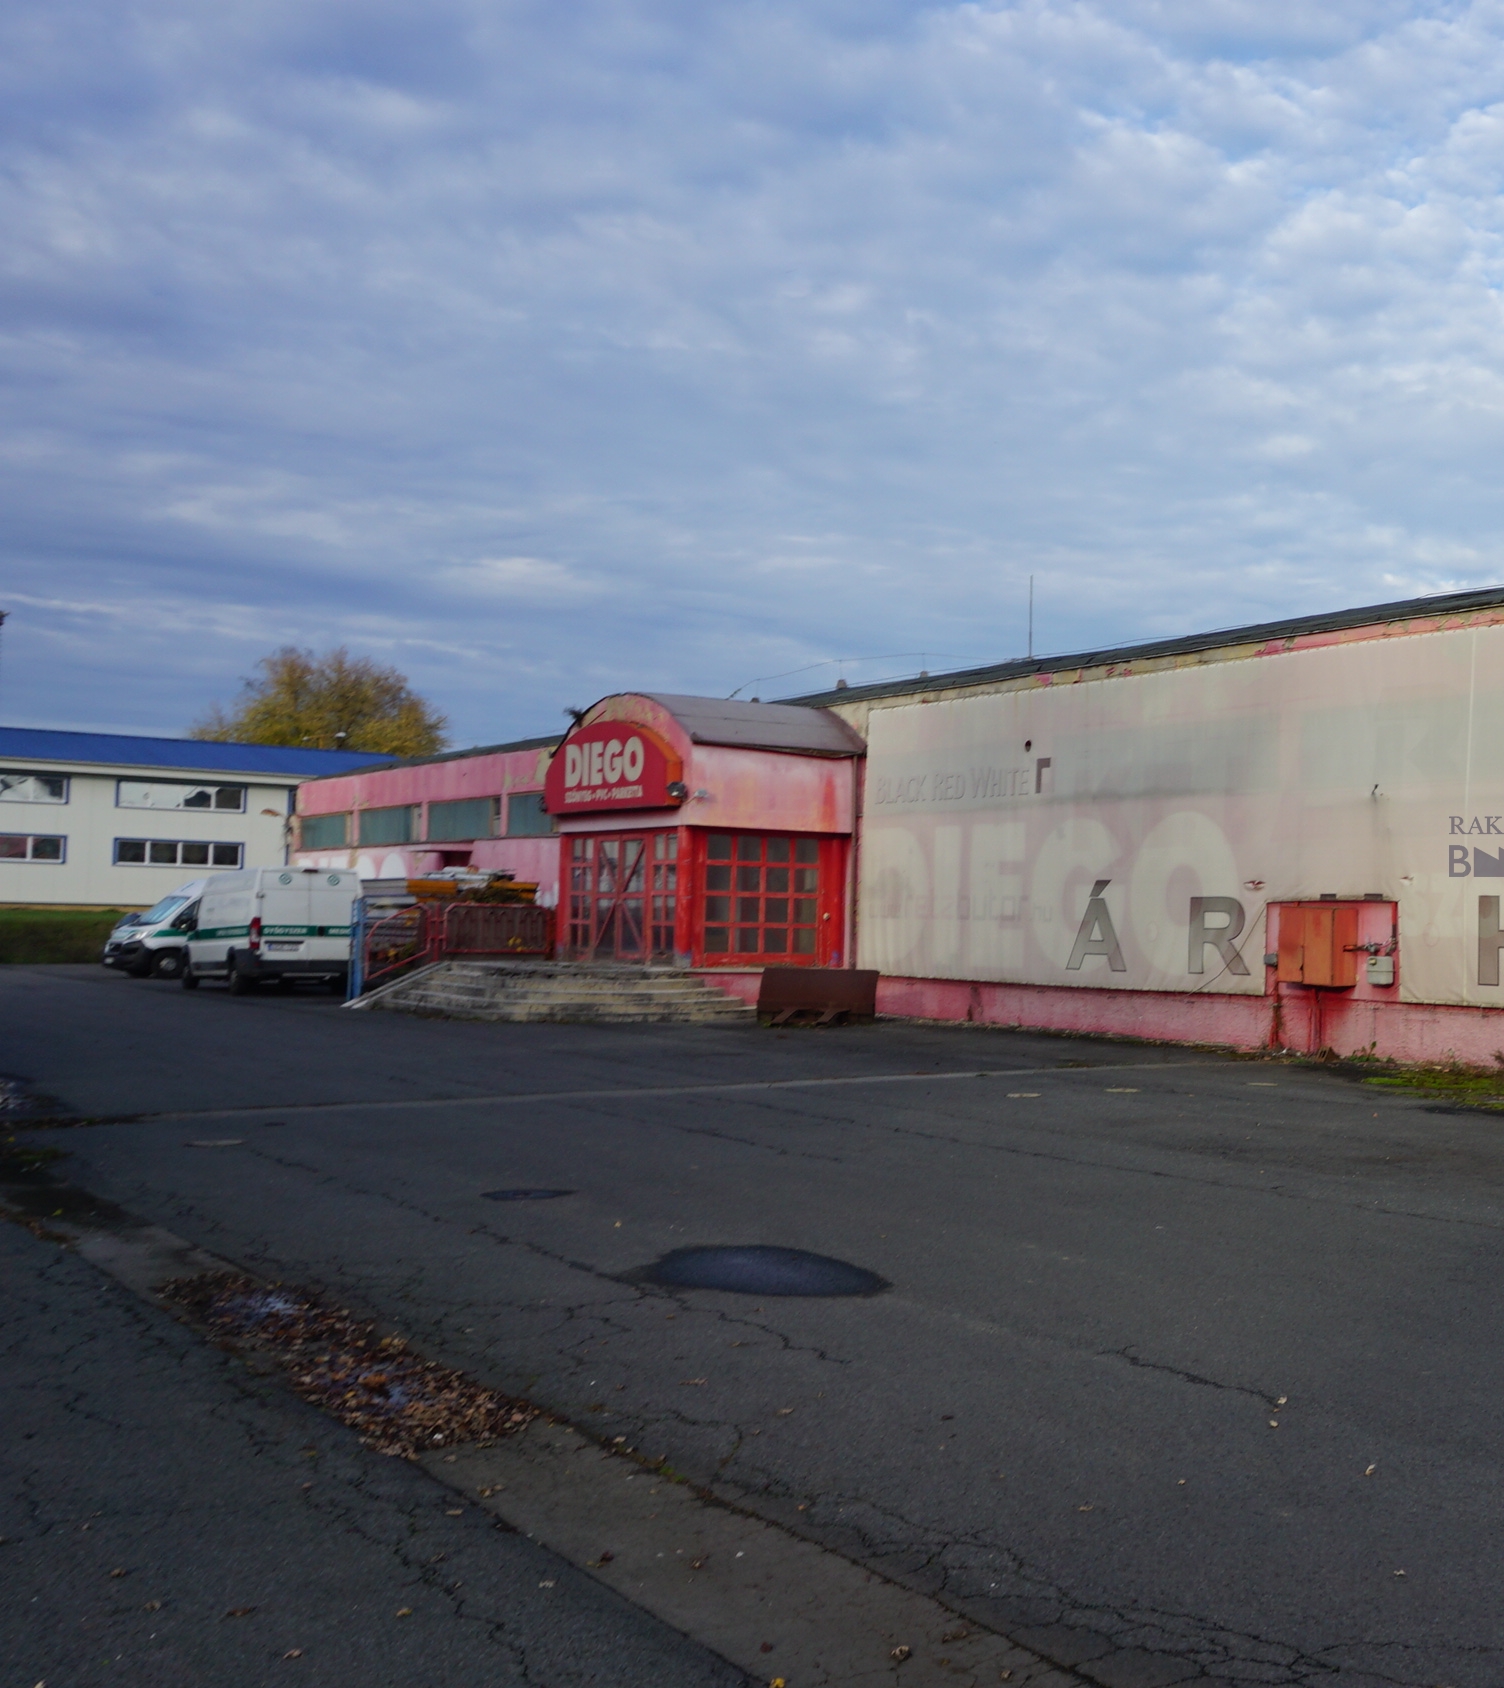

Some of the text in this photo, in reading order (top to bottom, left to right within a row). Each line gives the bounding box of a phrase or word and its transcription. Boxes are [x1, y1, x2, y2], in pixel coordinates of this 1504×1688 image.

[564, 736, 644, 788] DIEGO
[875, 766, 1030, 805] BLACK RED WHITE
[860, 811, 1239, 975] DIEGO
